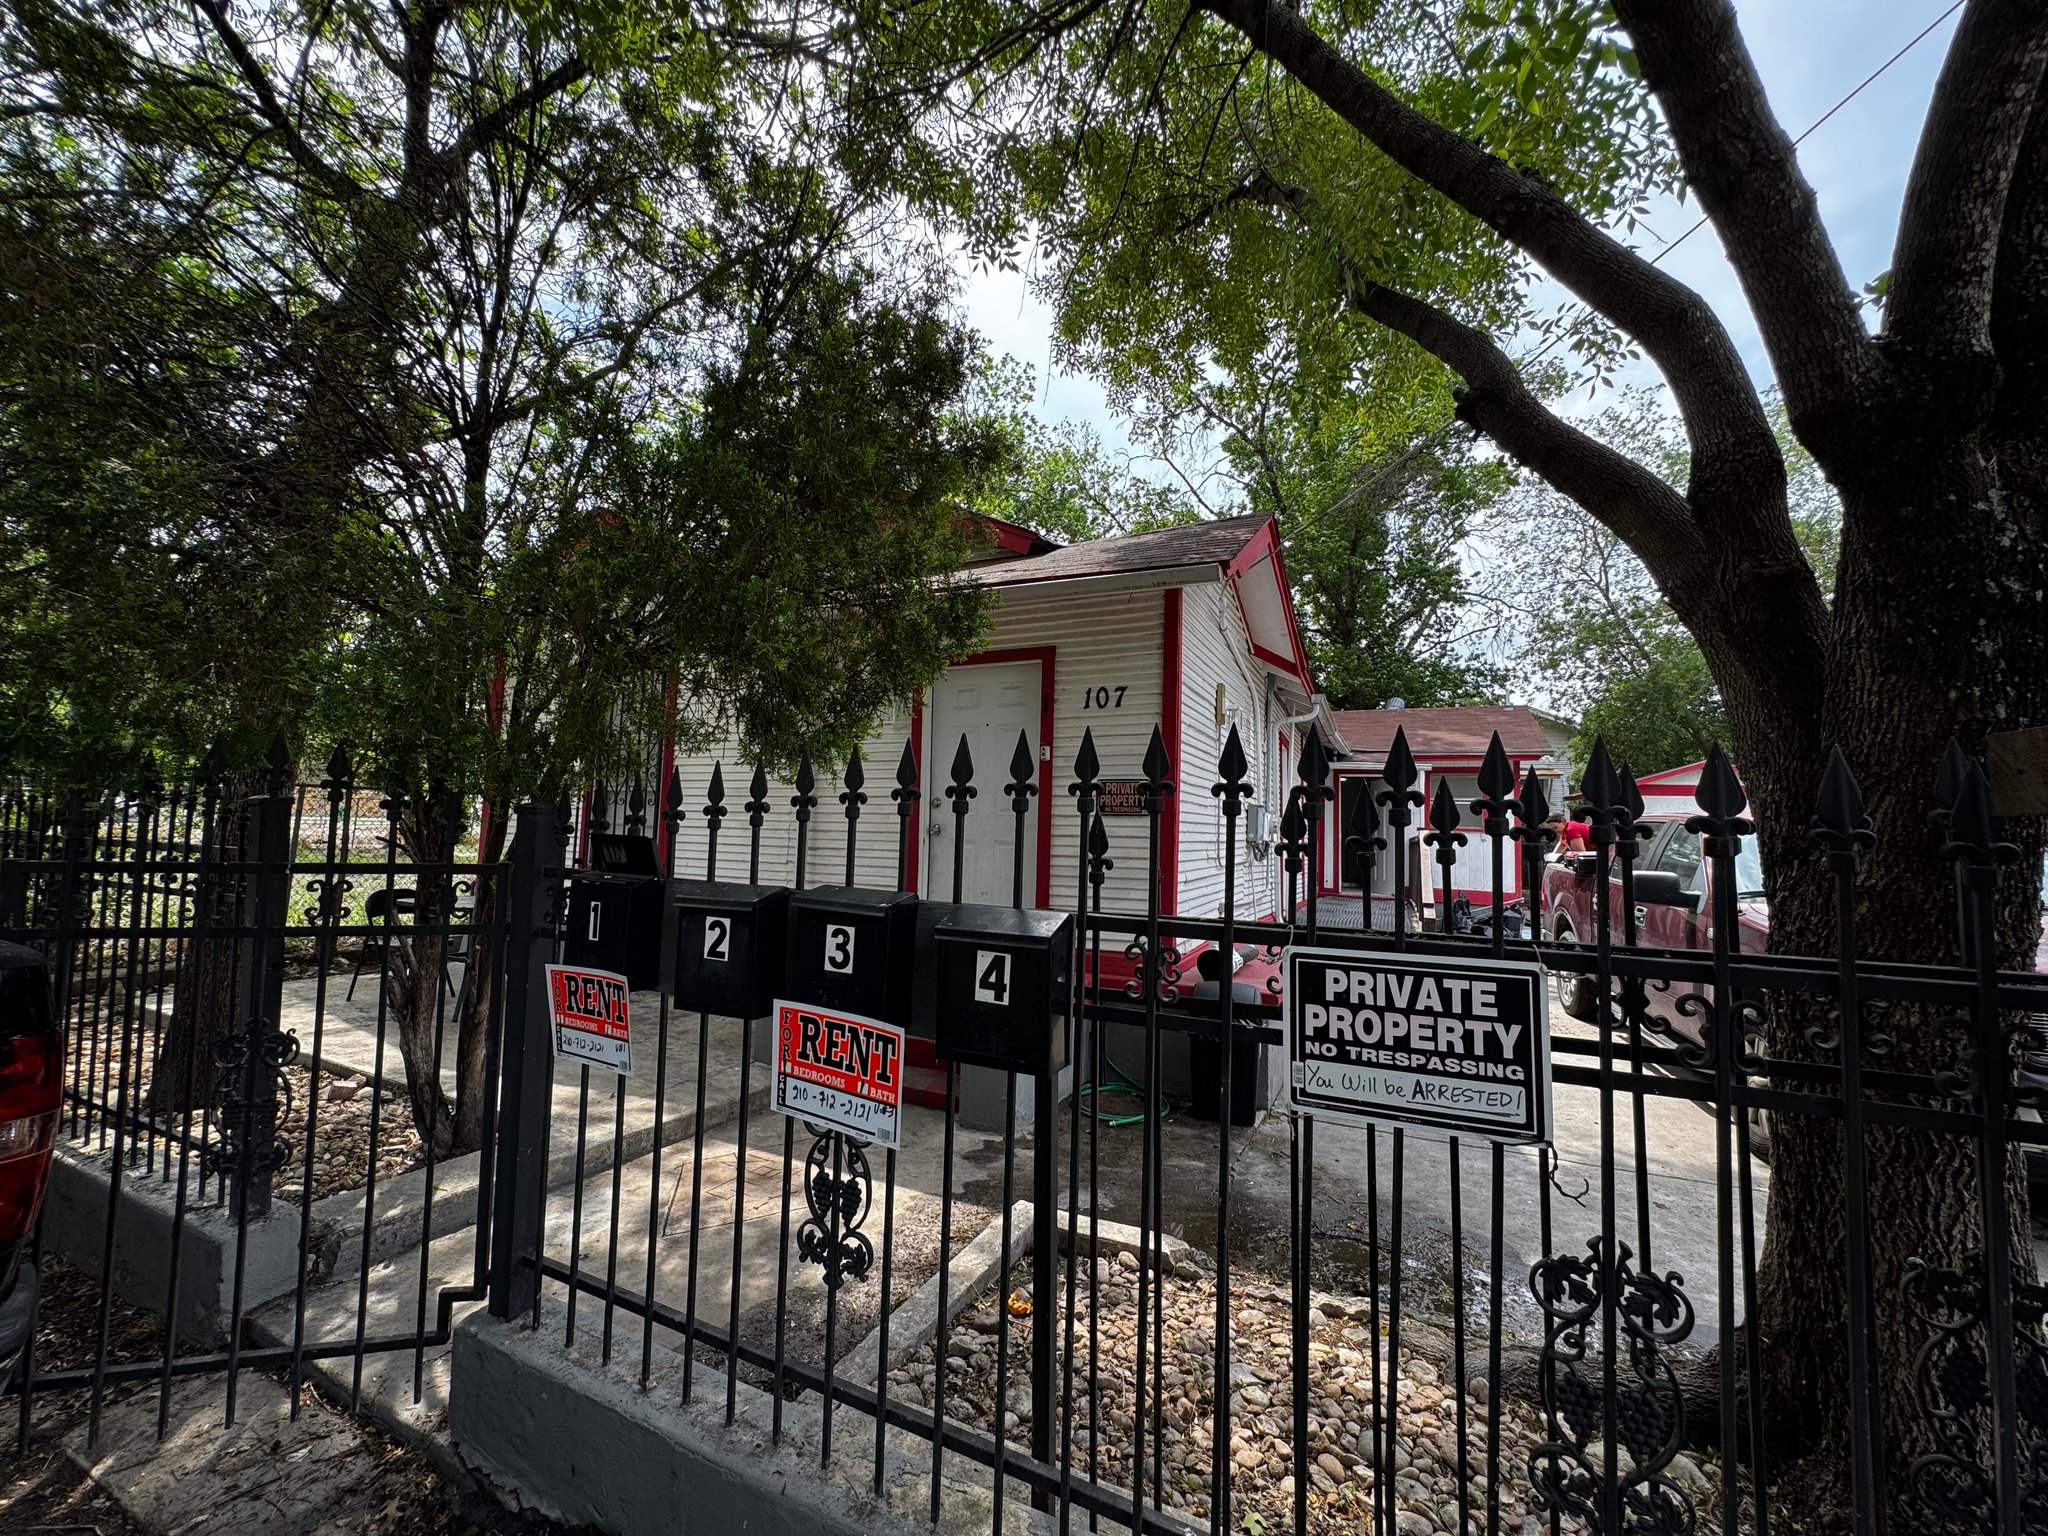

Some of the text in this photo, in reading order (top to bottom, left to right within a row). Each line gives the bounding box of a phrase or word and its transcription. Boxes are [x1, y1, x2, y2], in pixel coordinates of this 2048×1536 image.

[1083, 686, 1128, 709] 107
[1100, 794, 1147, 807] PROPERTY
[591, 903, 599, 939] 1
[706, 919, 728, 959] 2
[828, 928, 851, 970] 3
[553, 971, 563, 1013] FOR
[563, 973, 626, 1026] RENT
[979, 955, 1007, 1003] 4
[1325, 968, 1499, 1018] PRIVATE
[564, 1017, 599, 1032] BEDROOMS
[612, 1027, 629, 1040] BATH
[781, 1009, 793, 1059] FOR
[1304, 1002, 1523, 1060] PROPERTY
[796, 1013, 899, 1087] RENT
[1305, 1040, 1525, 1081] NO TRESPASSING
[793, 1065, 846, 1090] BEDROOMS
[870, 1086, 896, 1105] BATH
[1307, 1064, 1334, 1089] You
[1384, 1078, 1407, 1098] be
[1411, 1078, 1523, 1110] ARRESTED!
